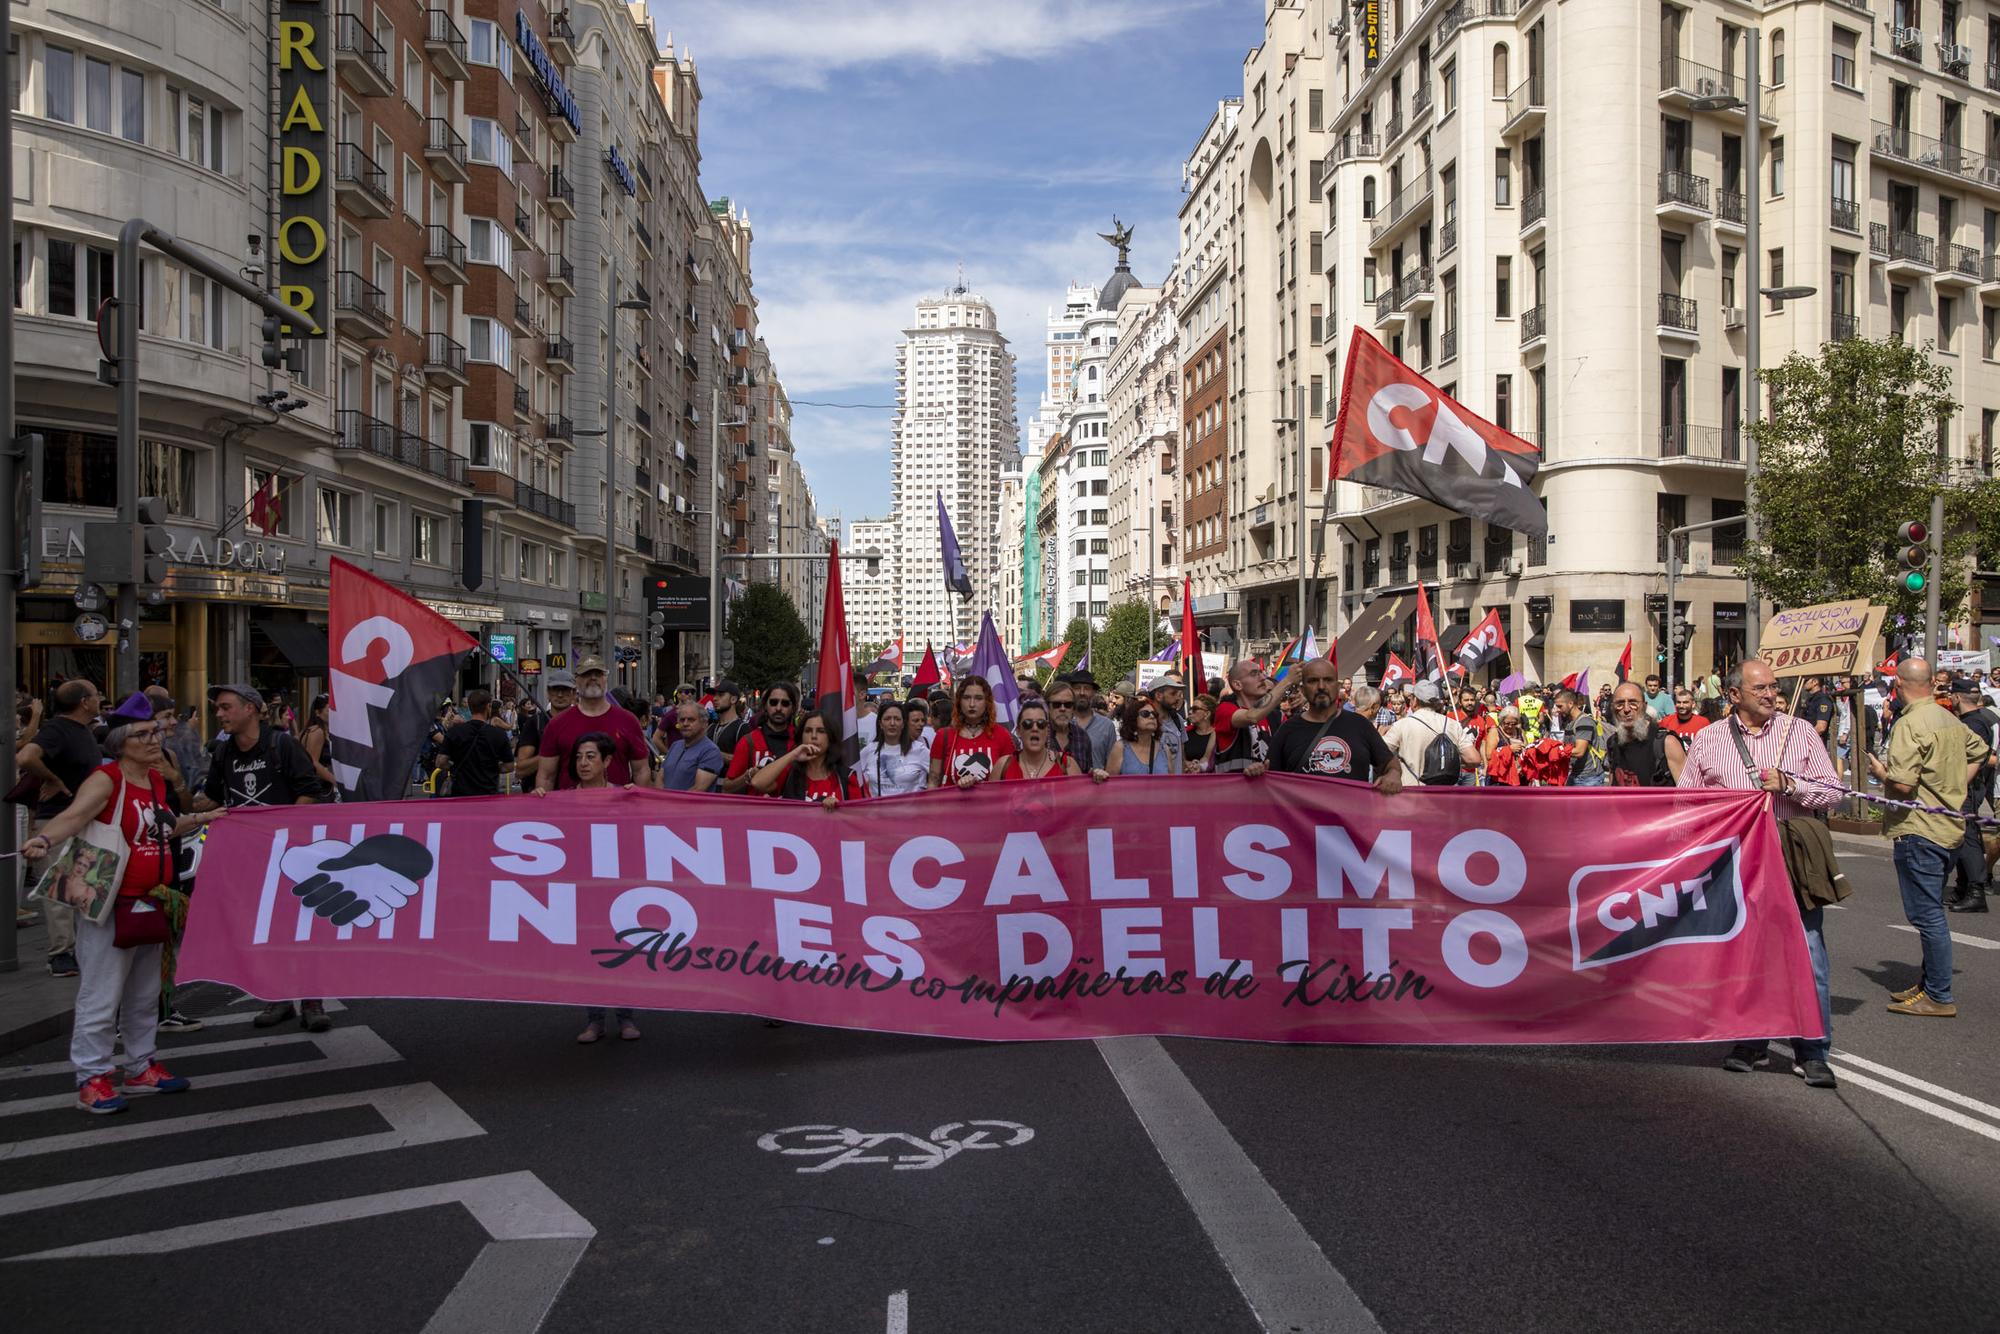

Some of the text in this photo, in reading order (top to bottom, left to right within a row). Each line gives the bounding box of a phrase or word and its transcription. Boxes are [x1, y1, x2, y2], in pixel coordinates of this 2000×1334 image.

[1047, 537, 1057, 594] SENATOR
[1775, 605, 1852, 625] ABSOLUCION
[1780, 623, 1813, 637] CNT
[490, 821, 1527, 910] SINDICALISMO
[1597, 870, 1713, 932] CNT
[489, 880, 1529, 988] NO ES DELITO
[590, 927, 1434, 1018] Absolución compañeras de Xixón
